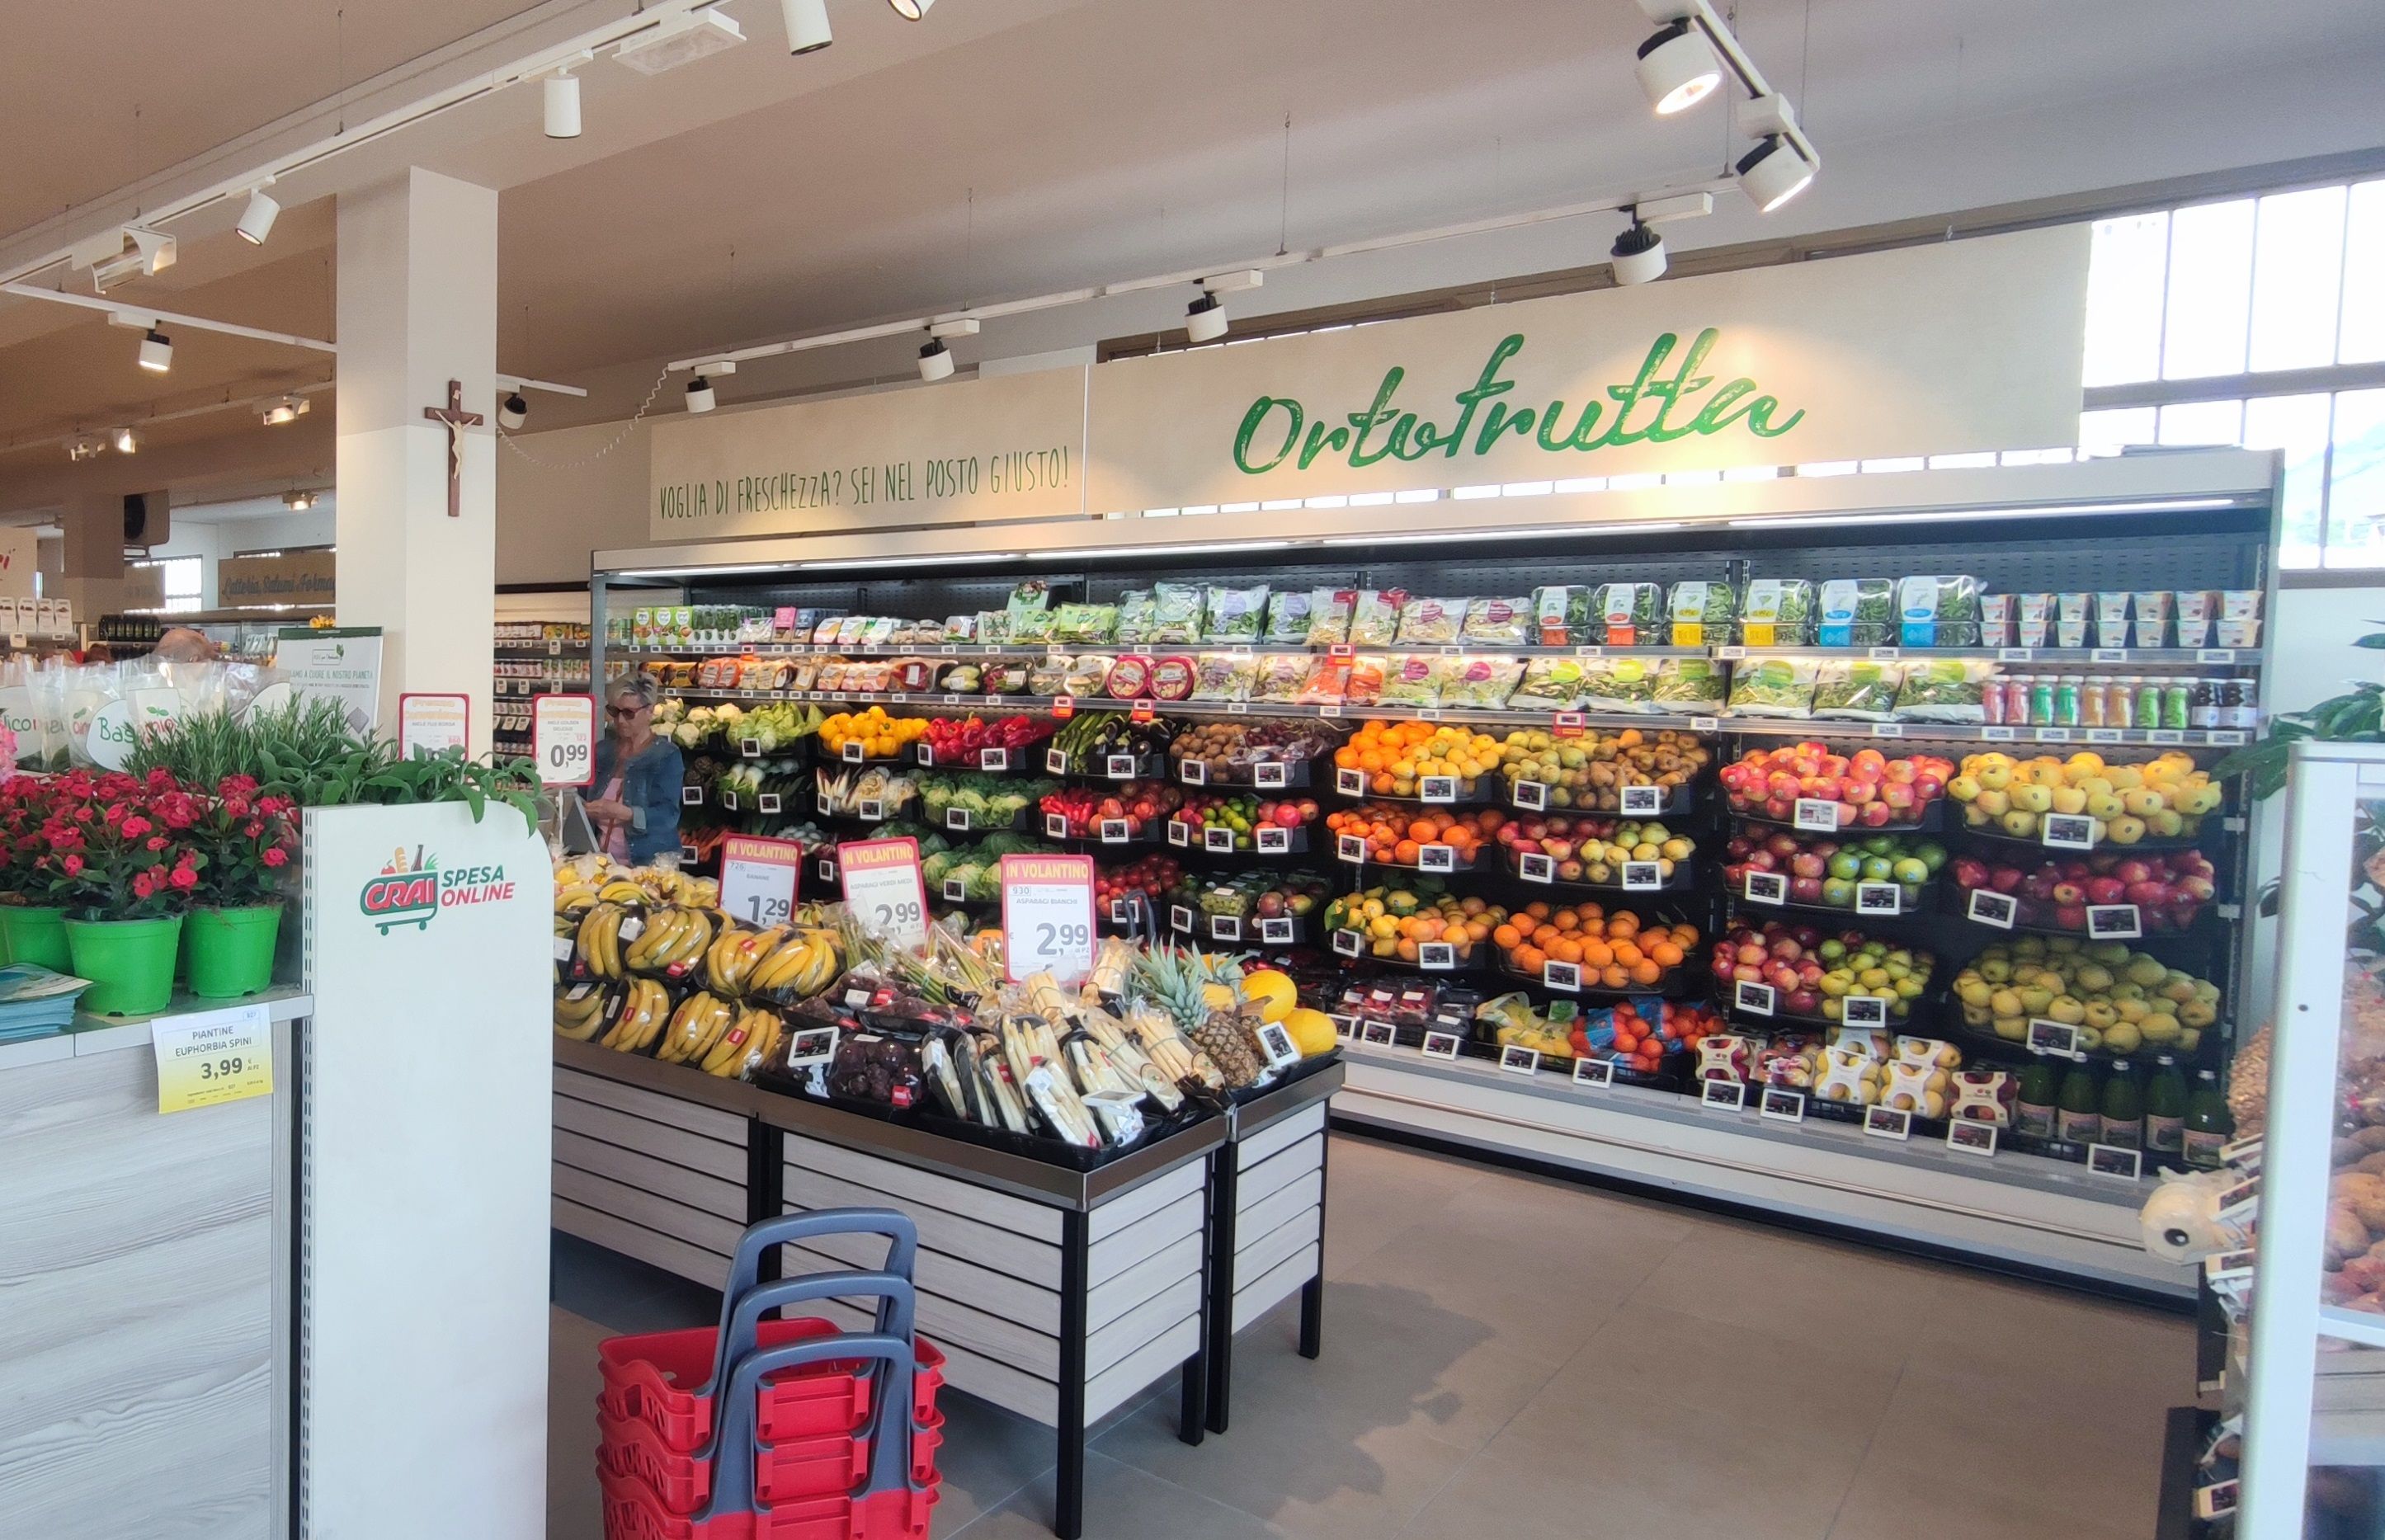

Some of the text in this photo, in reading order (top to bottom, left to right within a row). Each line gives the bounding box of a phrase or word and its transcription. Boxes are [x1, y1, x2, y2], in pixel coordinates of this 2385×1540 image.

[1233, 327, 1806, 474] Ortofrutta
[661, 445, 1068, 519] VOGLIA DI FRESCHEZZA? SEI NEL POSTO GIUSTO!
[550, 744, 588, 768] 0,99
[726, 841, 798, 860] IN VOLANTINO
[844, 845, 914, 865] IN VOLANTINO
[441, 865, 505, 888] SPESA
[1006, 863, 1089, 879] IN VOLANTINO
[365, 878, 436, 911] CRAI
[441, 882, 516, 907] ONLINE
[1012, 886, 1030, 895] 930
[747, 895, 790, 925] 1,29
[1036, 922, 1089, 956] 2,99
[192, 1026, 234, 1040] PIANTINE
[175, 1037, 252, 1057] EUPHORBIA SPINI
[200, 1057, 243, 1081] 3,99
